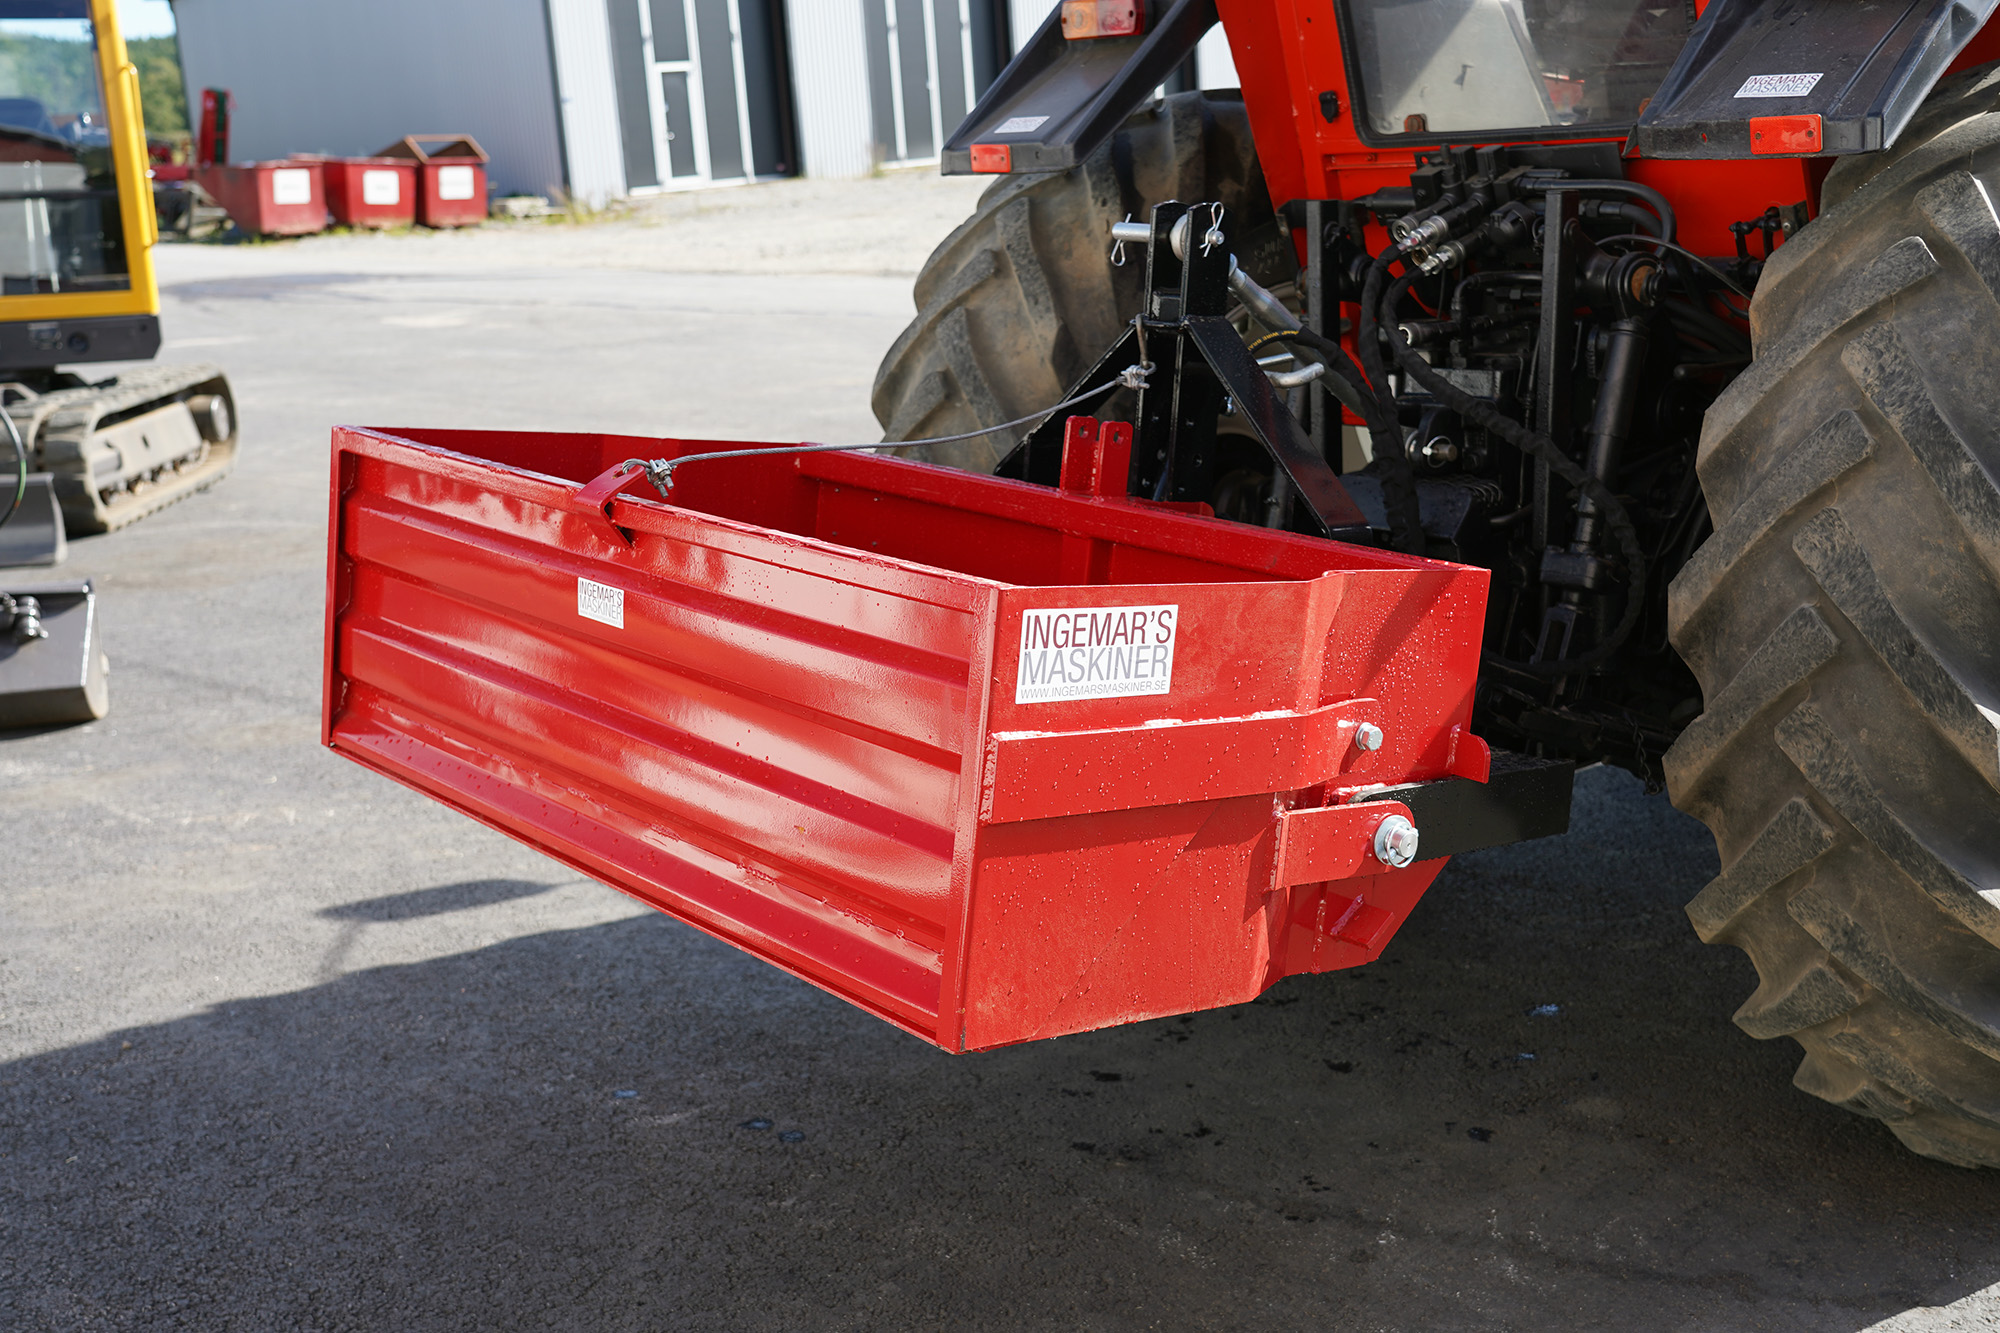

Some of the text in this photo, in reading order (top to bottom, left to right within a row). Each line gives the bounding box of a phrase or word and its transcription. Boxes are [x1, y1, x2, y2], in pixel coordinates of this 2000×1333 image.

[1739, 82, 1812, 94] MASKINER
[1745, 74, 1820, 86] INGEMAR'S
[579, 580, 623, 607] INGEMAR'S
[579, 594, 623, 621] MASKINER
[1024, 609, 1173, 650] INGEMAR'S
[1021, 644, 1169, 686] MASKINER
[1020, 680, 1167, 700] WWW.INGEMARSMASKINER.SE
